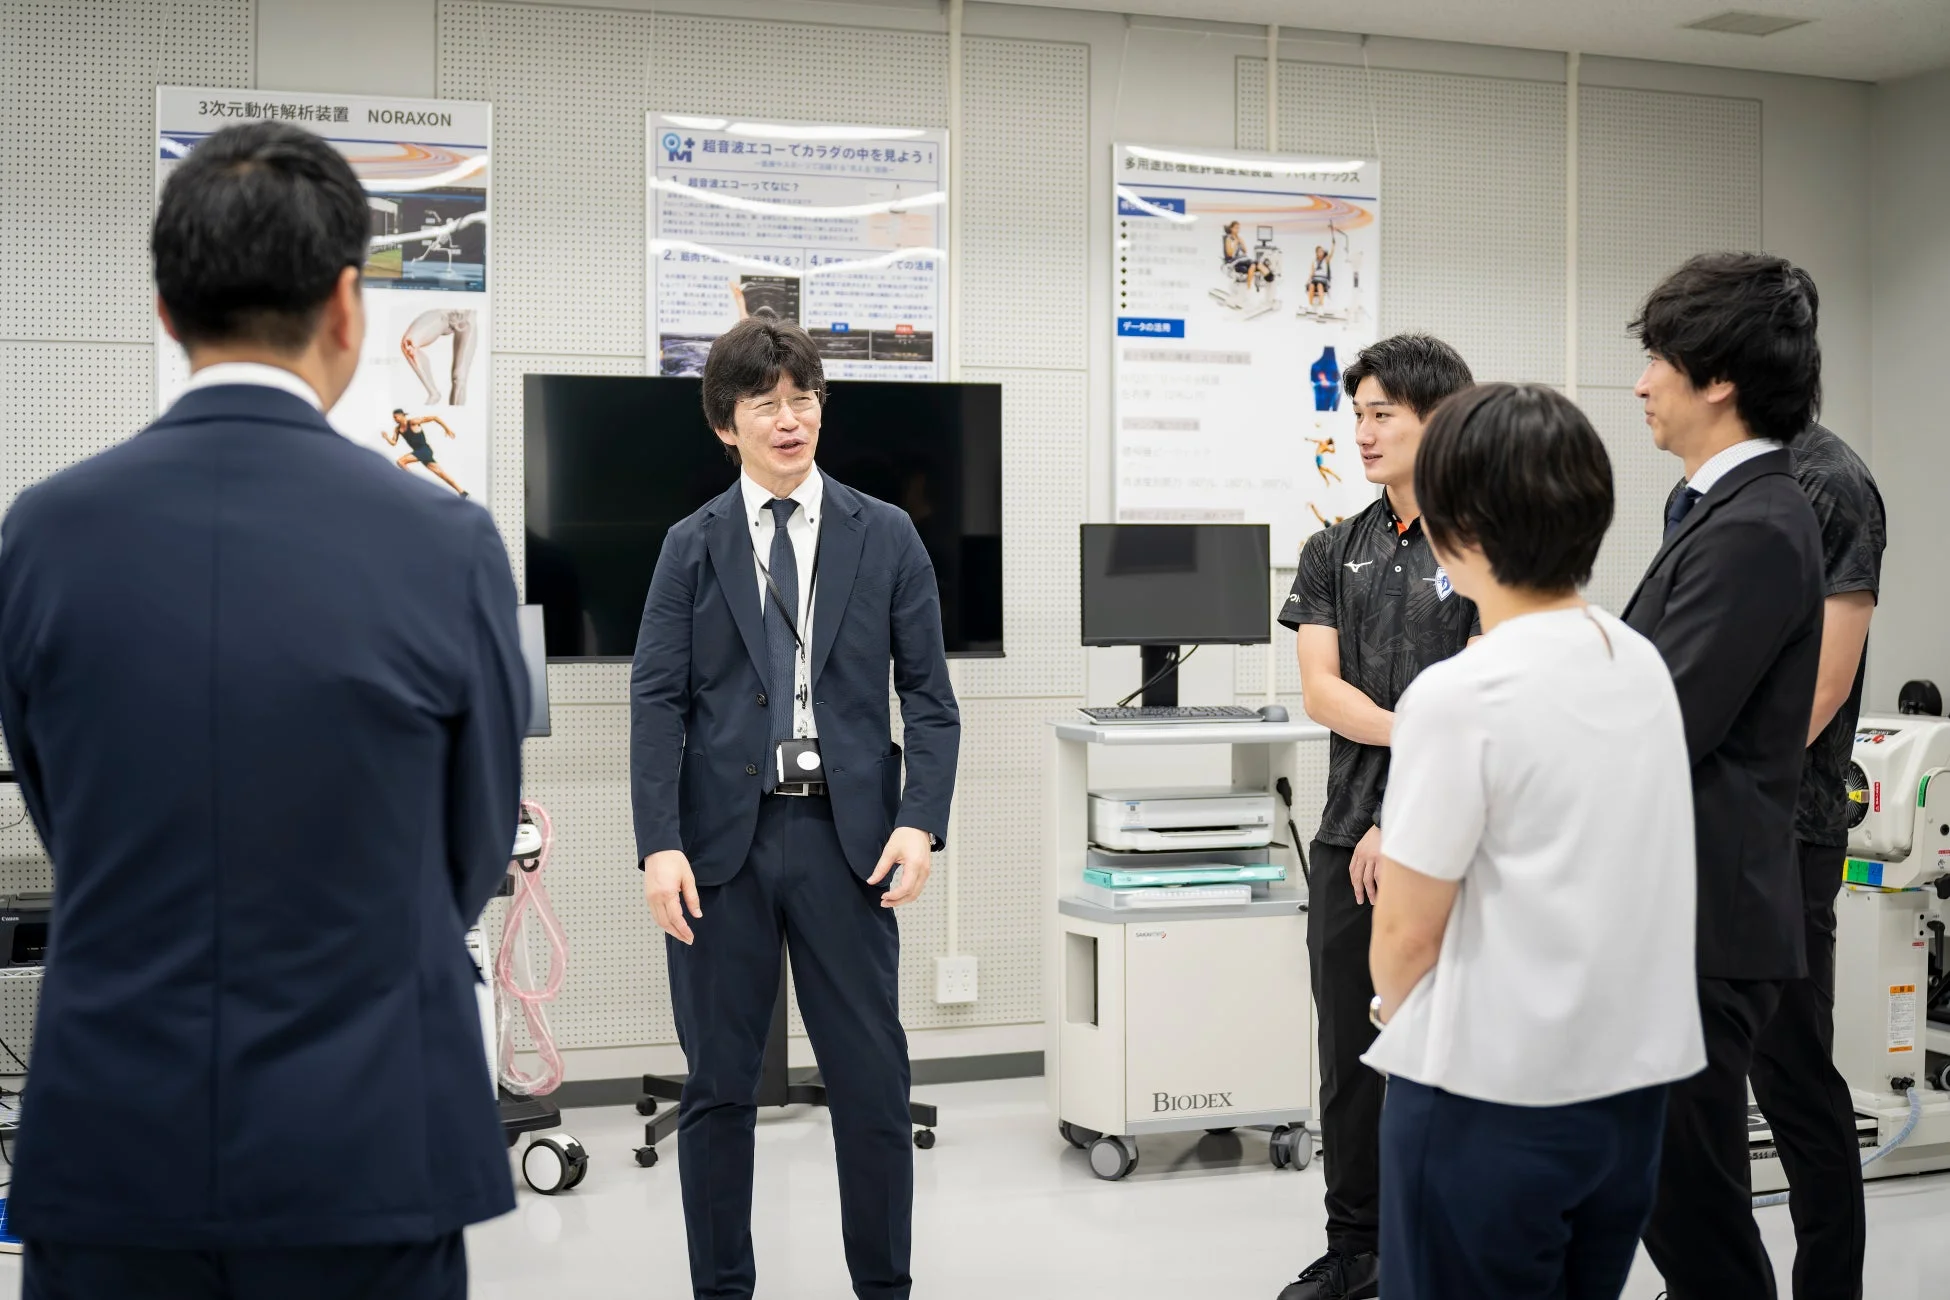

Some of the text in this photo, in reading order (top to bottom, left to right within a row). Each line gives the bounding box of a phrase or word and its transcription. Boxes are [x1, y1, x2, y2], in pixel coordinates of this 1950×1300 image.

[198, 100, 452, 127] 3次元動作解析装置 NORAXON
[1152, 1091, 1234, 1113] BIODEX
